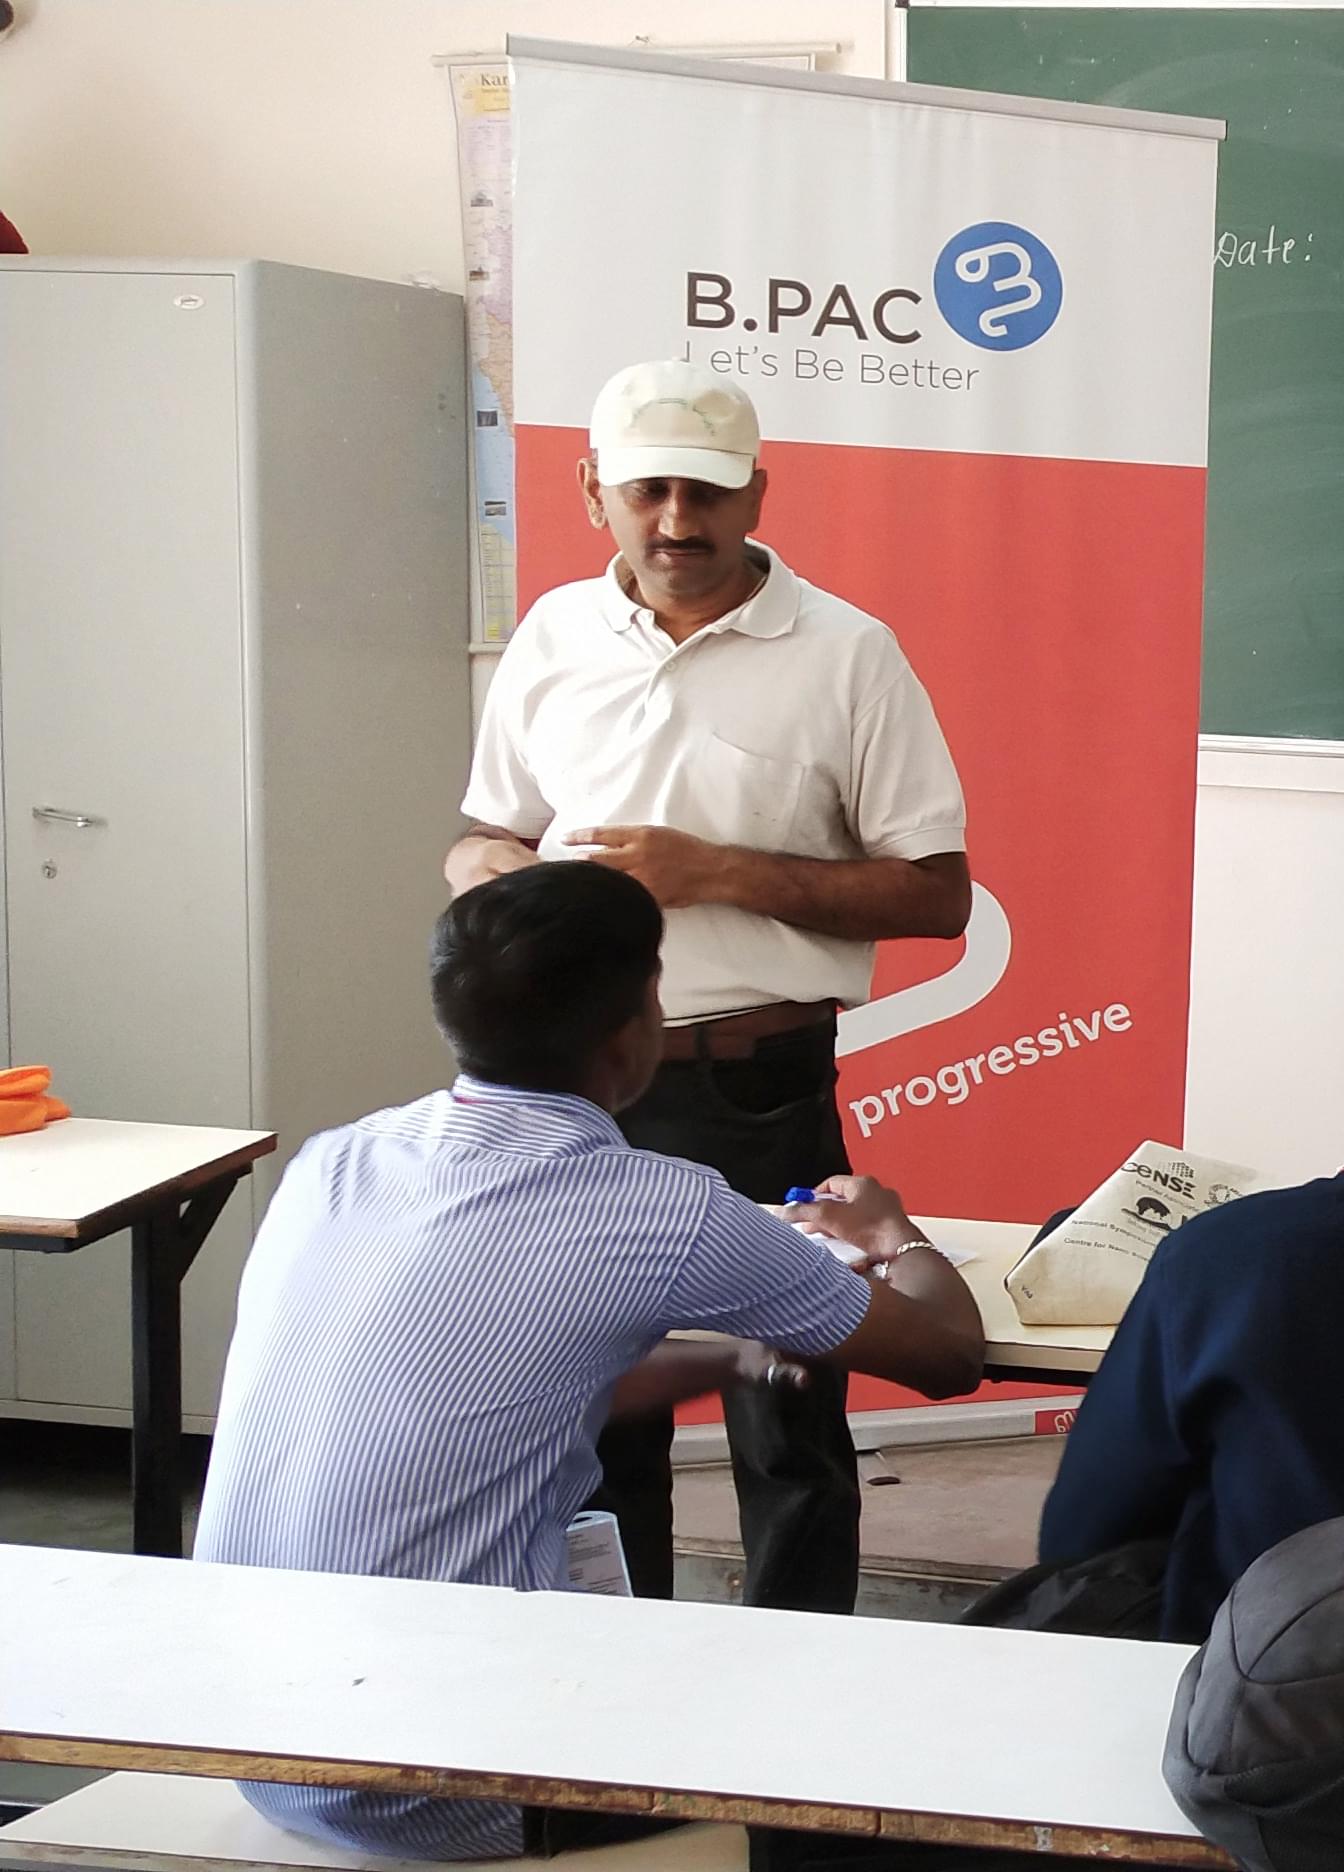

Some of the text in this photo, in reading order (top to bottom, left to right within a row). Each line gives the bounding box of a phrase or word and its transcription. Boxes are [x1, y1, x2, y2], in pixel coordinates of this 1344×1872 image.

[686, 271, 923, 345] B.PAC
[794, 349, 845, 382] Be
[859, 354, 980, 391] Better
[849, 1002, 1133, 1138] progressive
